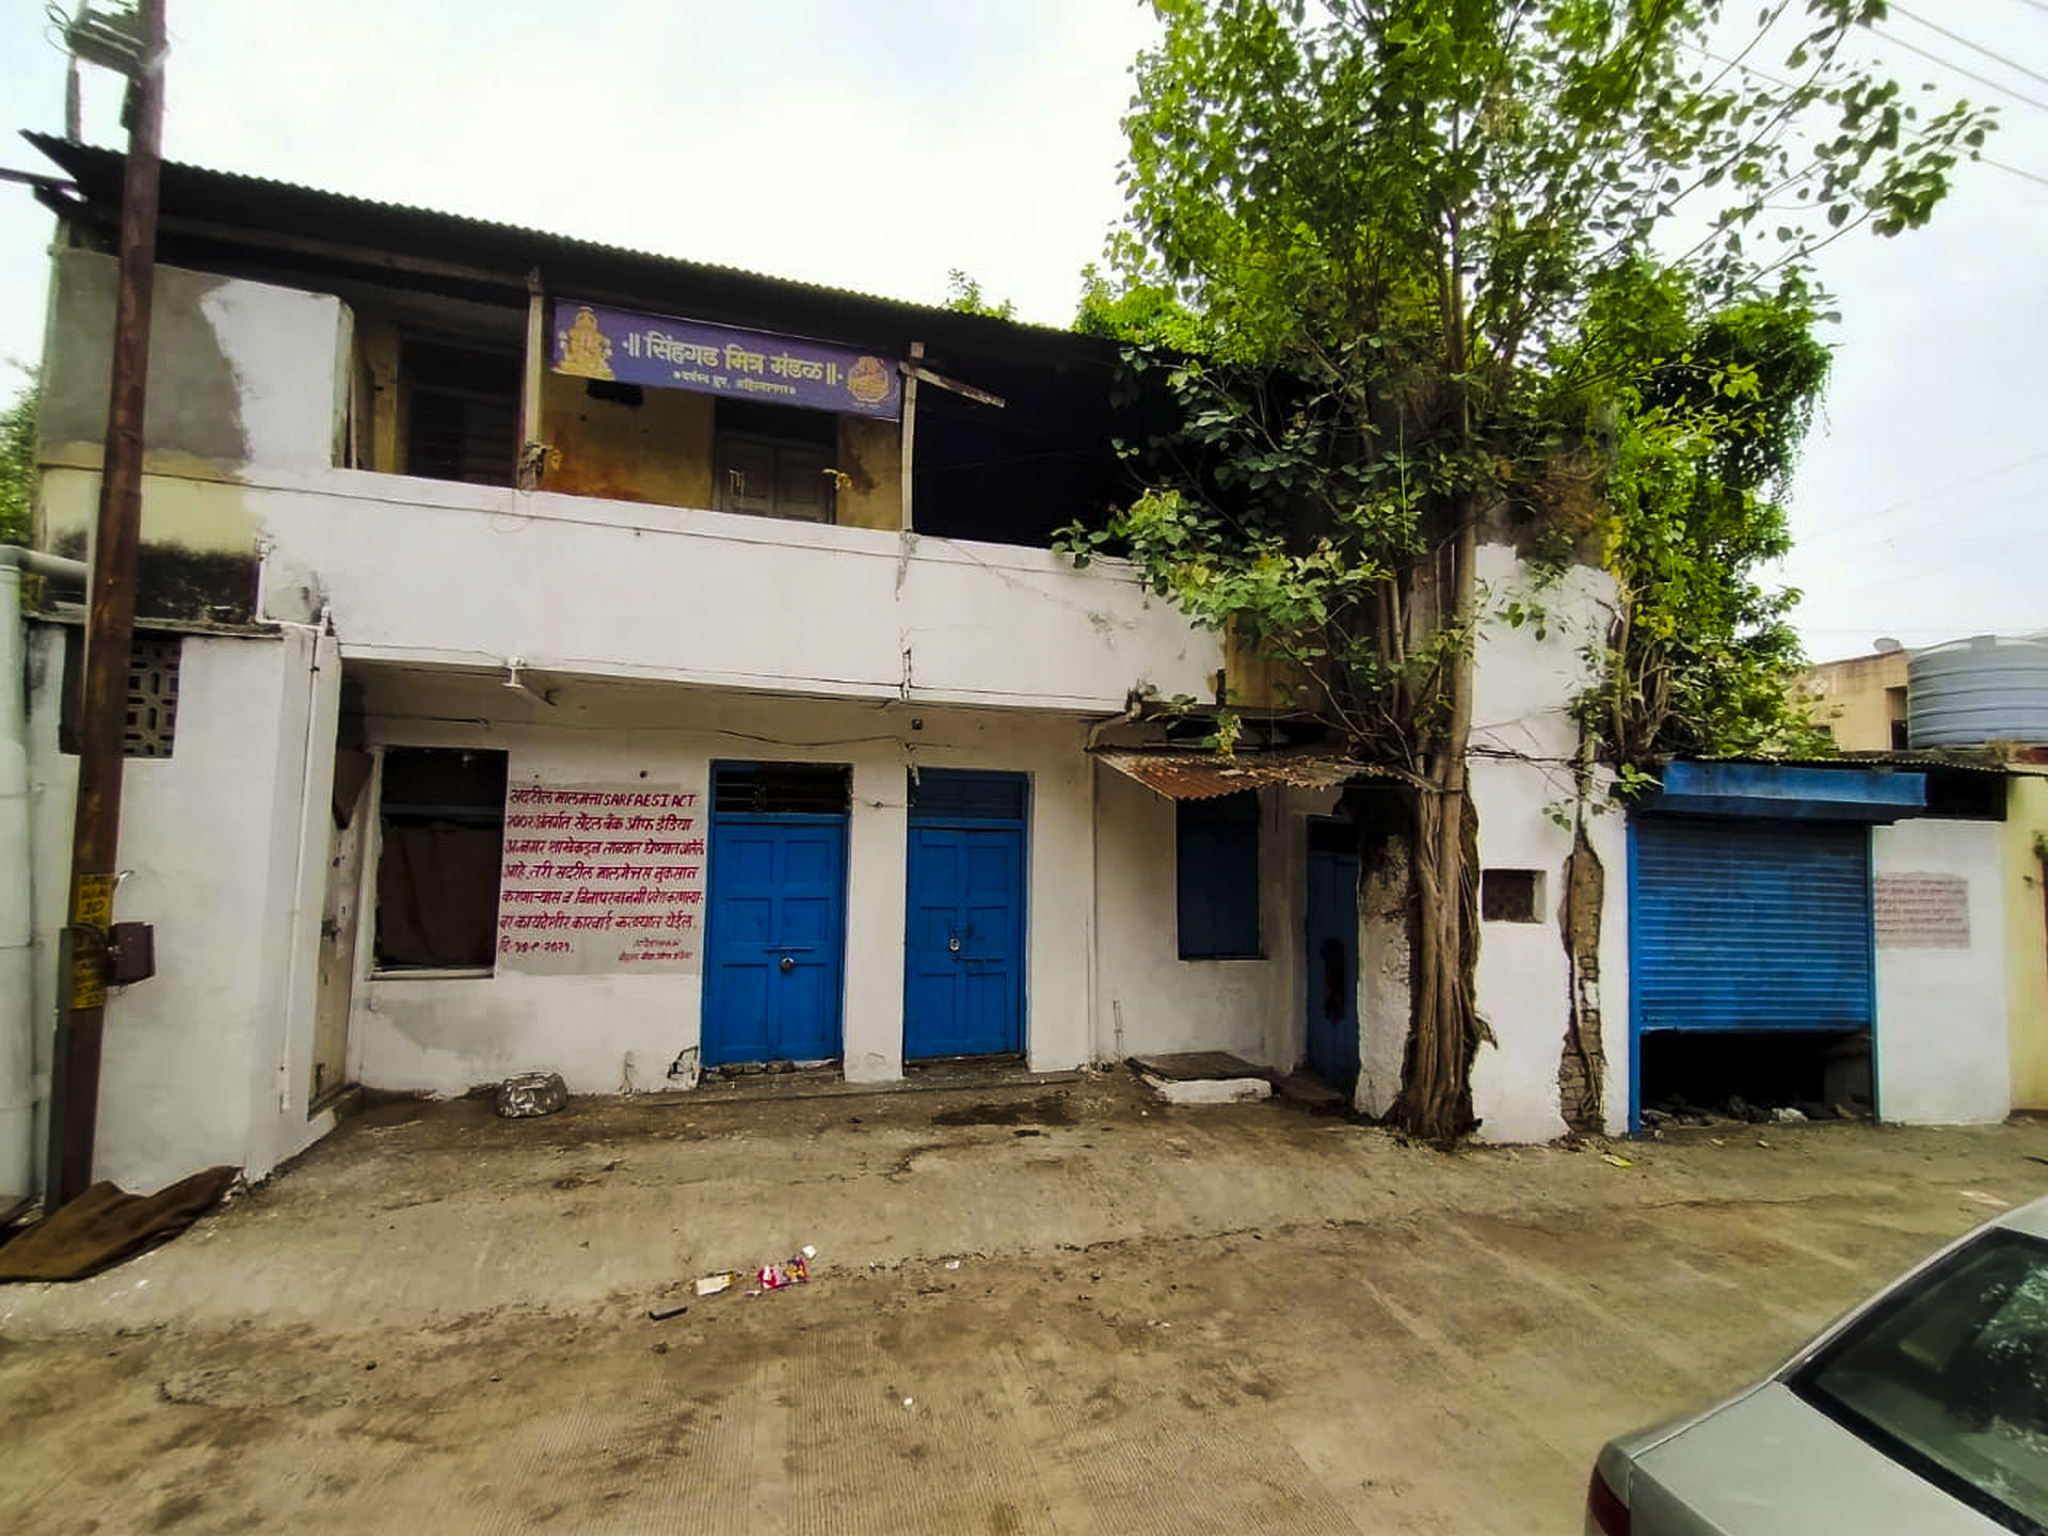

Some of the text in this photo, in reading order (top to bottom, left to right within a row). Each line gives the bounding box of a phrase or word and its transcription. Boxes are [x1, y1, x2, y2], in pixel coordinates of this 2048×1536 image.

[645, 331, 720, 366] सिंहगड
[723, 344, 767, 374] मित्र
[770, 352, 823, 380] मंडळ
[604, 793, 669, 806] SARFAESI
[671, 794, 697, 807] ACT
[530, 860, 554, 878] तरी
